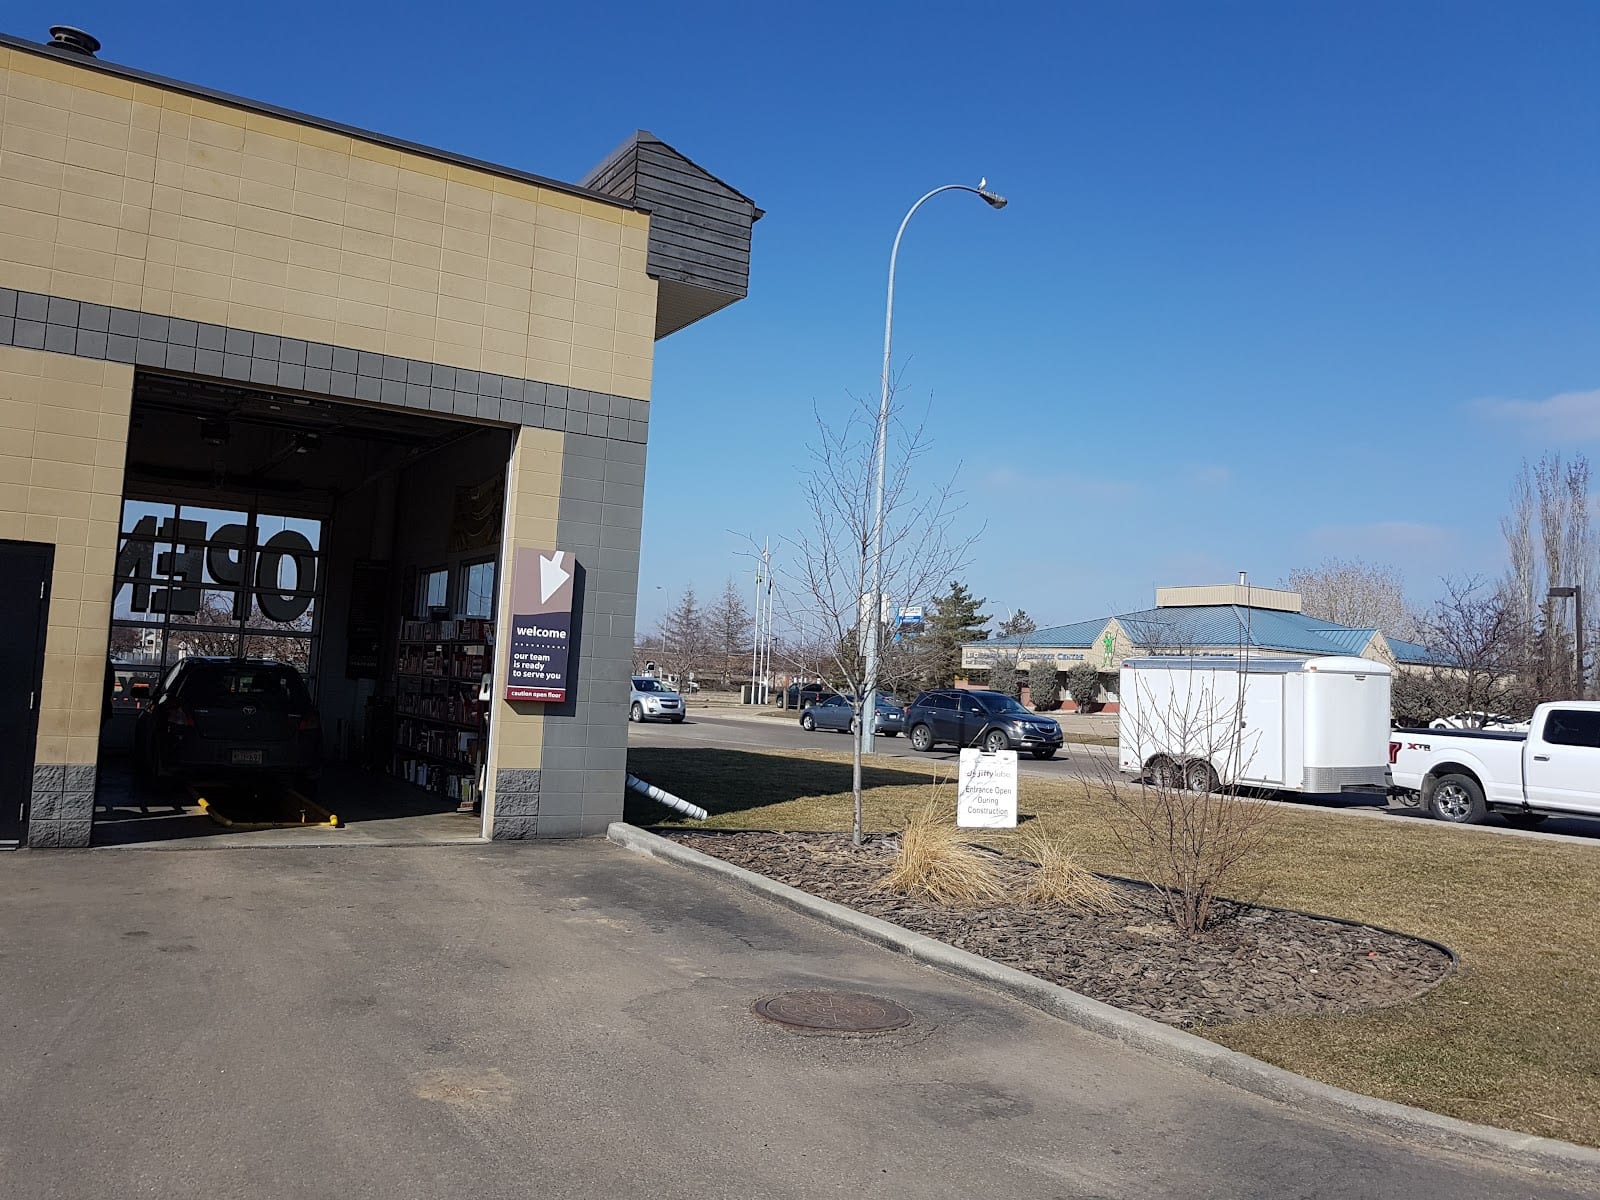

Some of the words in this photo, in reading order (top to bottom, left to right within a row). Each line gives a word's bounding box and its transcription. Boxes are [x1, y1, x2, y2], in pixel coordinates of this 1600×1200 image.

[516, 625, 567, 639] welcome
[513, 652, 529, 660] our
[529, 653, 551, 662] team
[513, 660, 521, 668] is
[521, 661, 545, 672] ready
[512, 669, 522, 677] to
[522, 670, 545, 679] serve
[545, 672, 561, 681] you
[547, 691, 561, 699] floor
[1407, 742, 1431, 752] XTR
[977, 770, 994, 779] jiffy
[965, 785, 993, 794] Entrance
[994, 786, 1012, 795] Open
[977, 796, 999, 806] During
[967, 805, 1009, 815] Construction
